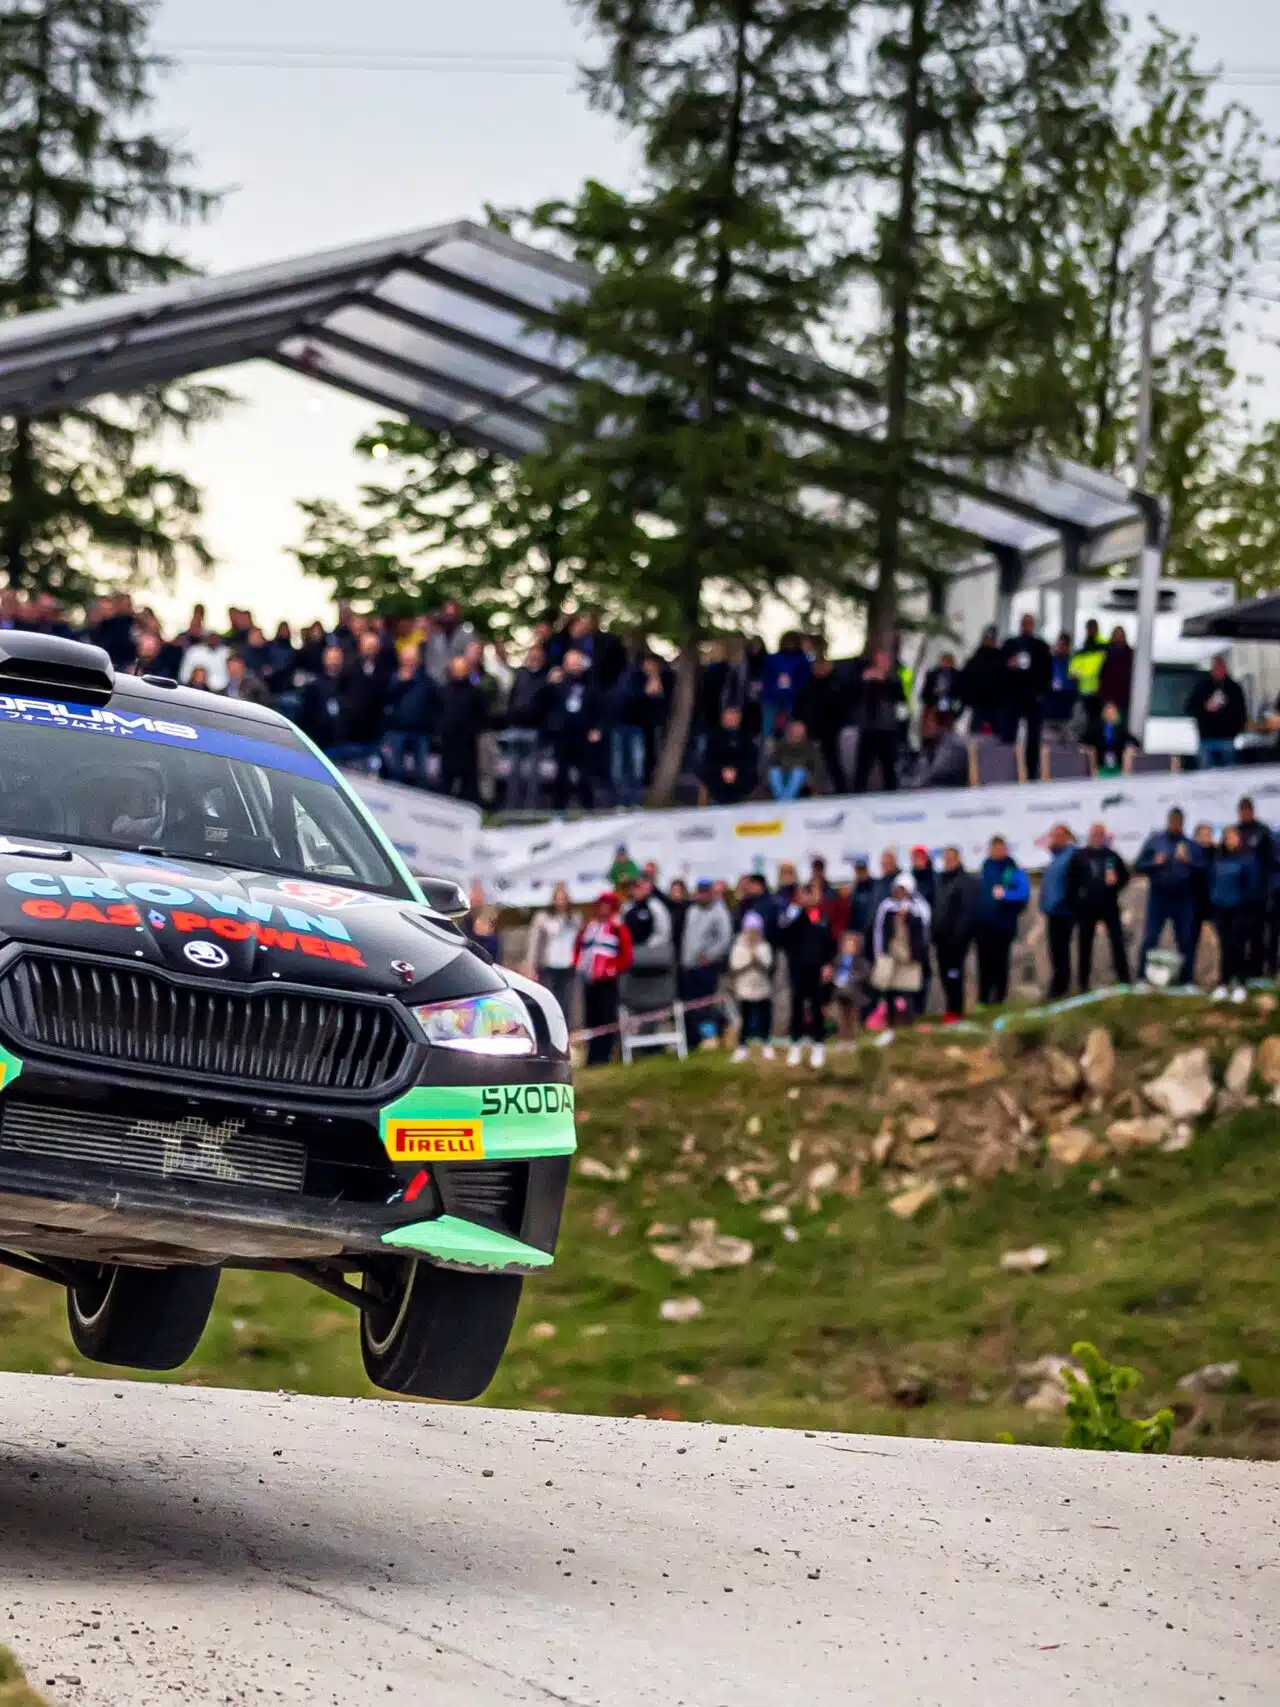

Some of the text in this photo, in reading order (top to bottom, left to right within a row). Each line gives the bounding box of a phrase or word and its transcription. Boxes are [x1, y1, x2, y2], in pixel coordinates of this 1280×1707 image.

[6, 710, 133, 736] フォーラムエイト
[5, 872, 352, 942] CROWN
[21, 899, 142, 927] GAS
[171, 910, 369, 968] POWER
[396, 1128, 475, 1152] PIRELLI
